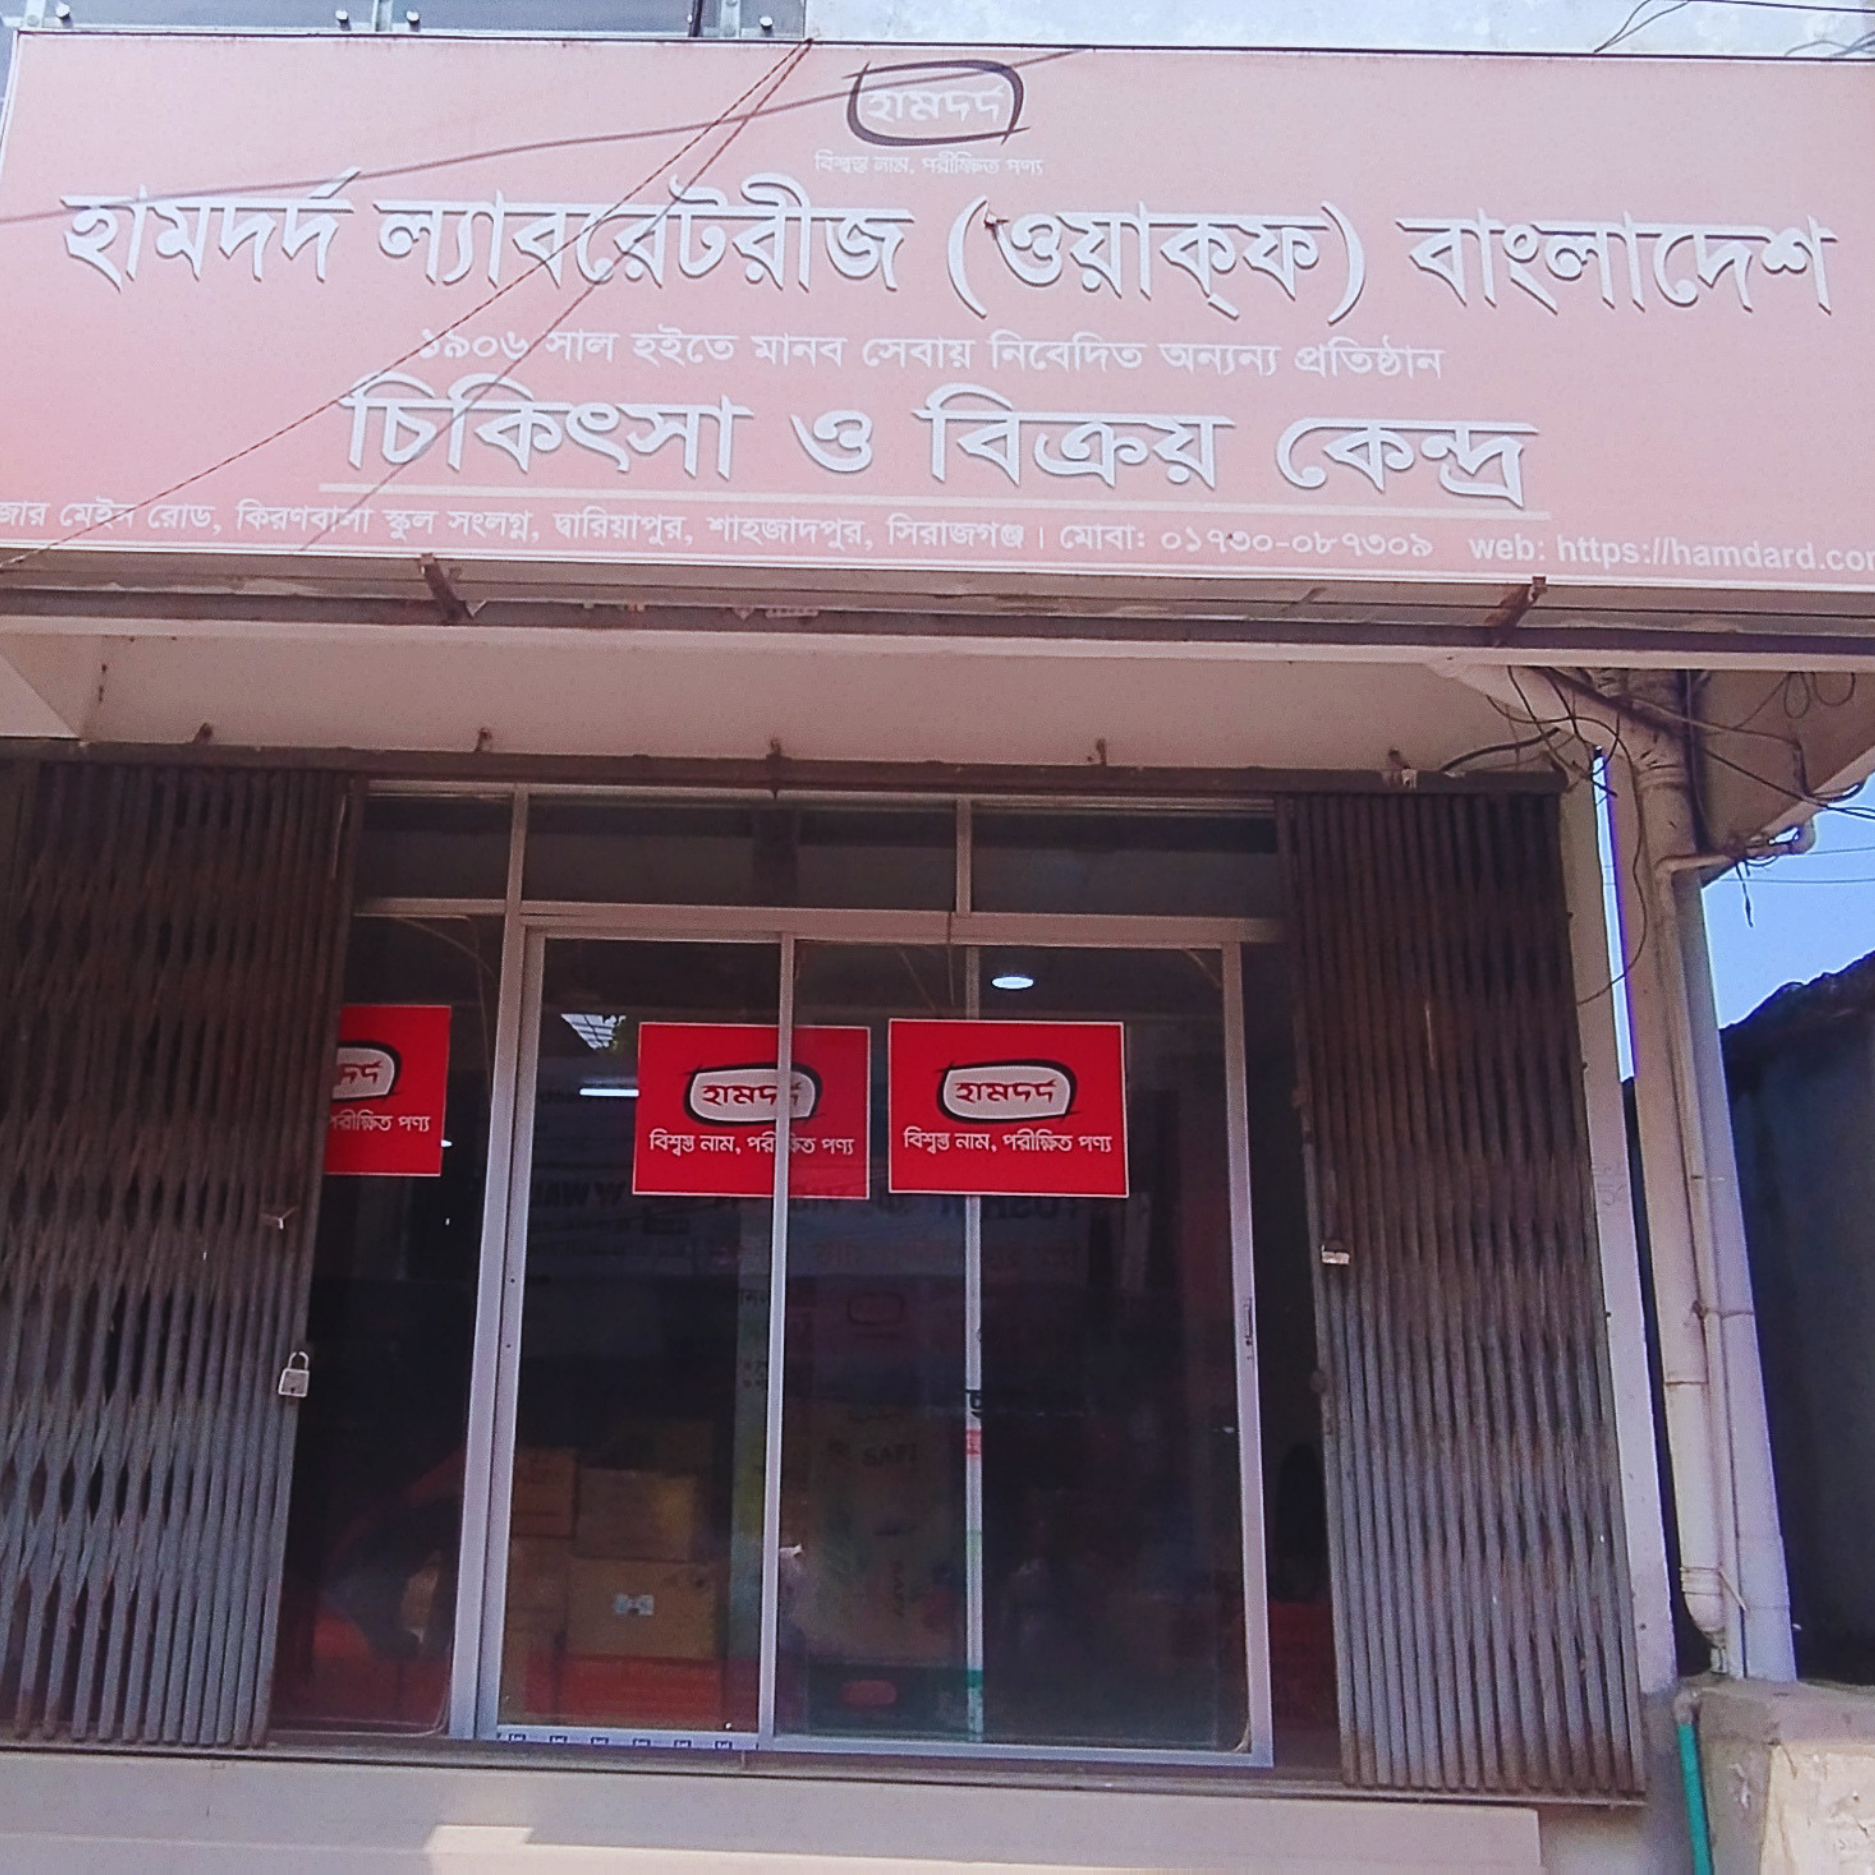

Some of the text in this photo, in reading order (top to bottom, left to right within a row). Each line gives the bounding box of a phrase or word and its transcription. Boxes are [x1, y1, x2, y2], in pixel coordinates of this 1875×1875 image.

[866, 85, 1004, 122] হামদর্দ
[61, 167, 361, 293] হামদর্দ
[373, 174, 914, 293] ল্যাবরেটরীজ
[1396, 207, 1838, 315] বাংলাদেশ
[419, 328, 530, 360] ১৯০৬
[545, 328, 620, 361] সাল
[631, 323, 735, 367] হইতে
[751, 334, 847, 366] মানব
[861, 336, 975, 371] সেবায়
[991, 329, 1144, 374] নিবেদিত
[1294, 335, 1446, 379] প্রতিষ্ঠান
[338, 372, 1539, 509] চিকিৎসা ও বিক্রয় কেন্দ্র
[60, 497, 138, 528] মেইন
[149, 503, 222, 535] রোড,
[382, 508, 438, 541] স্কুল
[448, 509, 539, 543] সংলগ্ন,
[552, 505, 692, 546] দ্বারিয়াপুর,
[706, 513, 874, 551] শাহজাদপুর,
[887, 512, 1025, 550] সিরাজগঞ্জ
[1160, 526, 1433, 558] ০১৭৩০-০৮৭৩০৯
[1469, 534, 1546, 562] web:
[953, 1078, 1057, 1103] হামদর্দ
[398, 1115, 430, 1133] পণ্য
[649, 1128, 695, 1156] বিশ্বস্ত
[699, 1135, 742, 1155] নাম,
[821, 1138, 855, 1155] পণ্য
[903, 1126, 1113, 1153] বিশ্বস্ত নাম, পরীক্ষিত পণ্য
